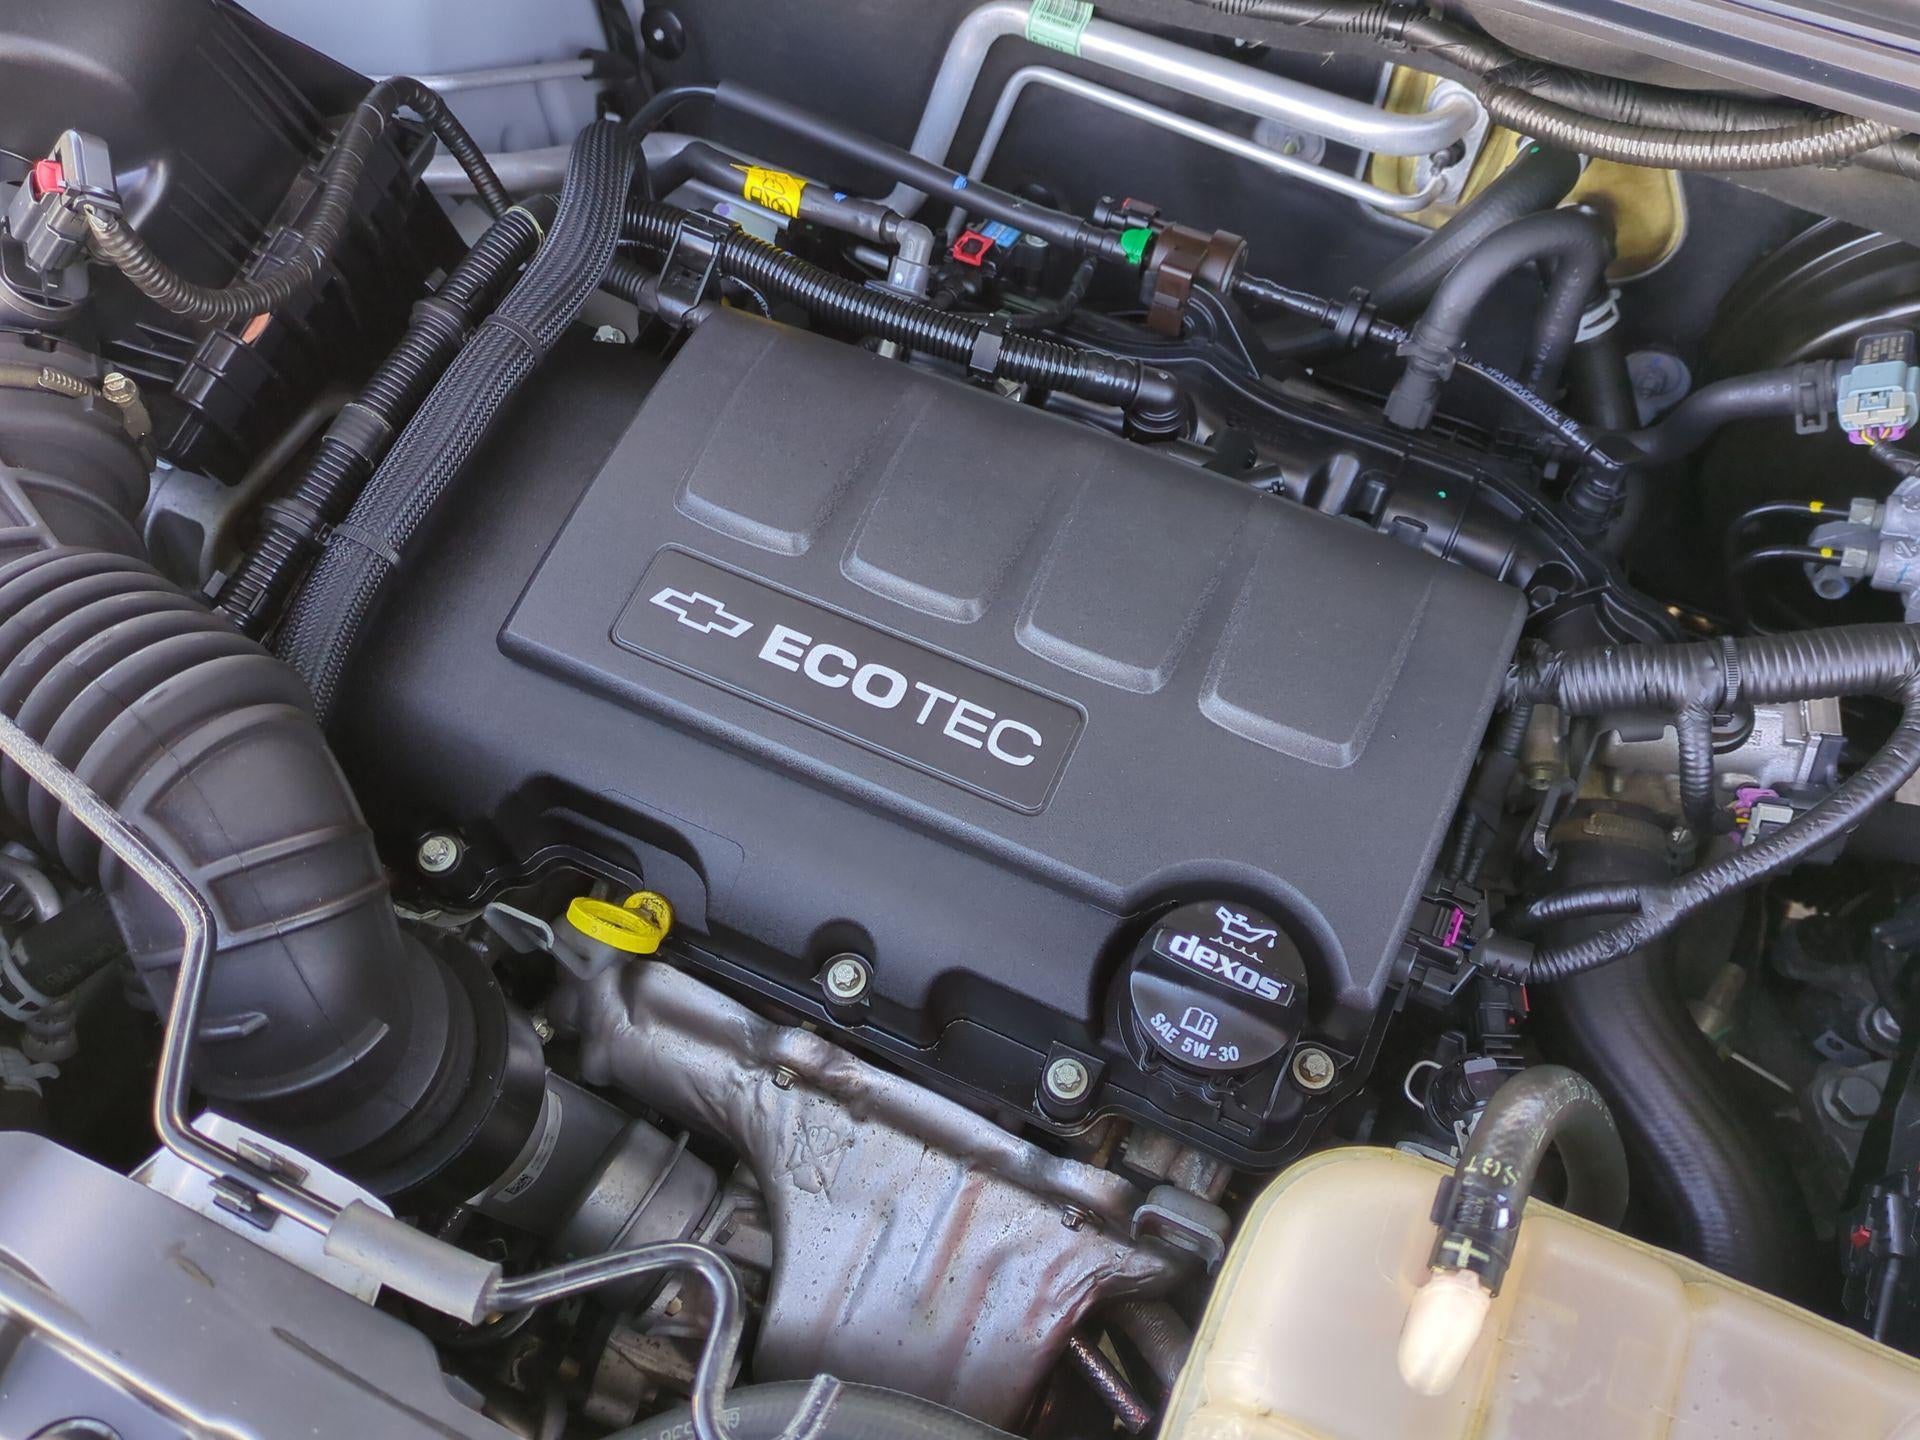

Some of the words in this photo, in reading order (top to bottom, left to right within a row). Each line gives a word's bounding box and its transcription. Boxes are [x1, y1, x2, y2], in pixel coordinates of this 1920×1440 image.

[758, 623, 1042, 766] ECOTEC
[1168, 934, 1287, 1001] dexos
[1150, 1012, 1181, 1043] SAE
[1181, 1037, 1240, 1063] 5W-30
